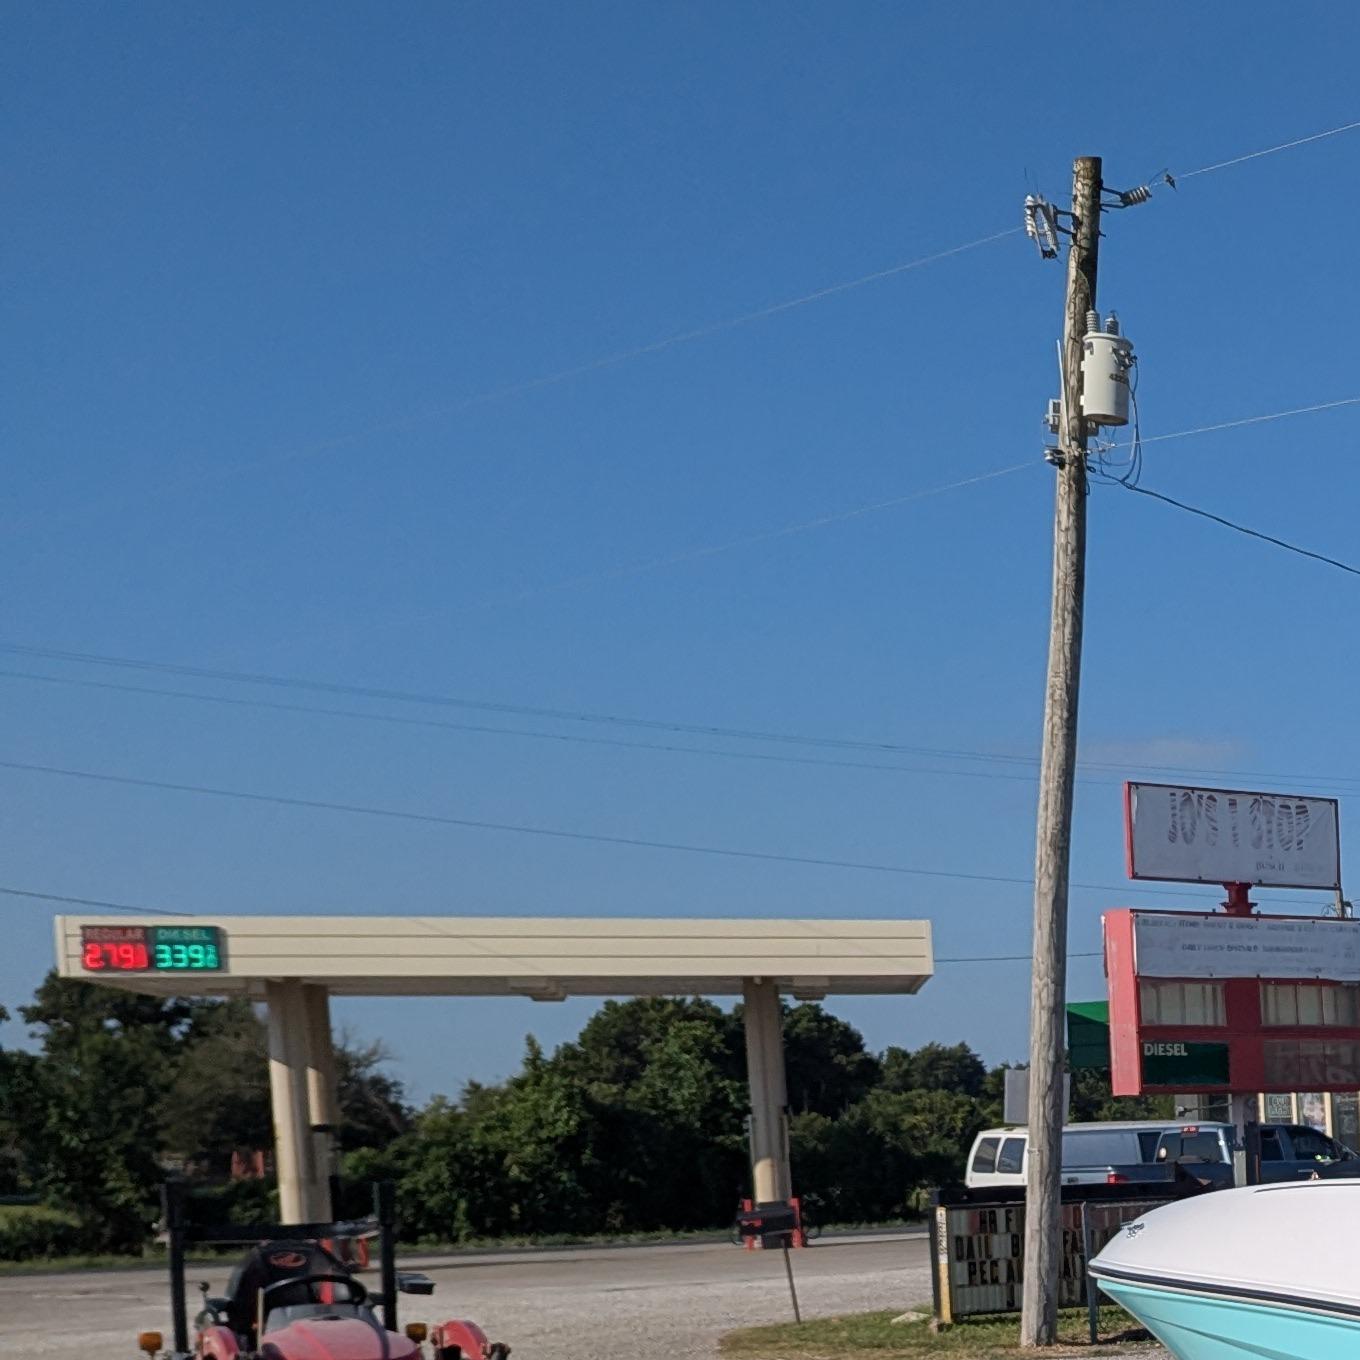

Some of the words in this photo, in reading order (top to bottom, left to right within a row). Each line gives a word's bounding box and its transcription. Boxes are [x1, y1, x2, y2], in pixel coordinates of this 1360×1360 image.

[1250, 798, 1311, 852] STOP
[157, 928, 212, 941] DIESEL
[1144, 1043, 1188, 1057] DIESEL
